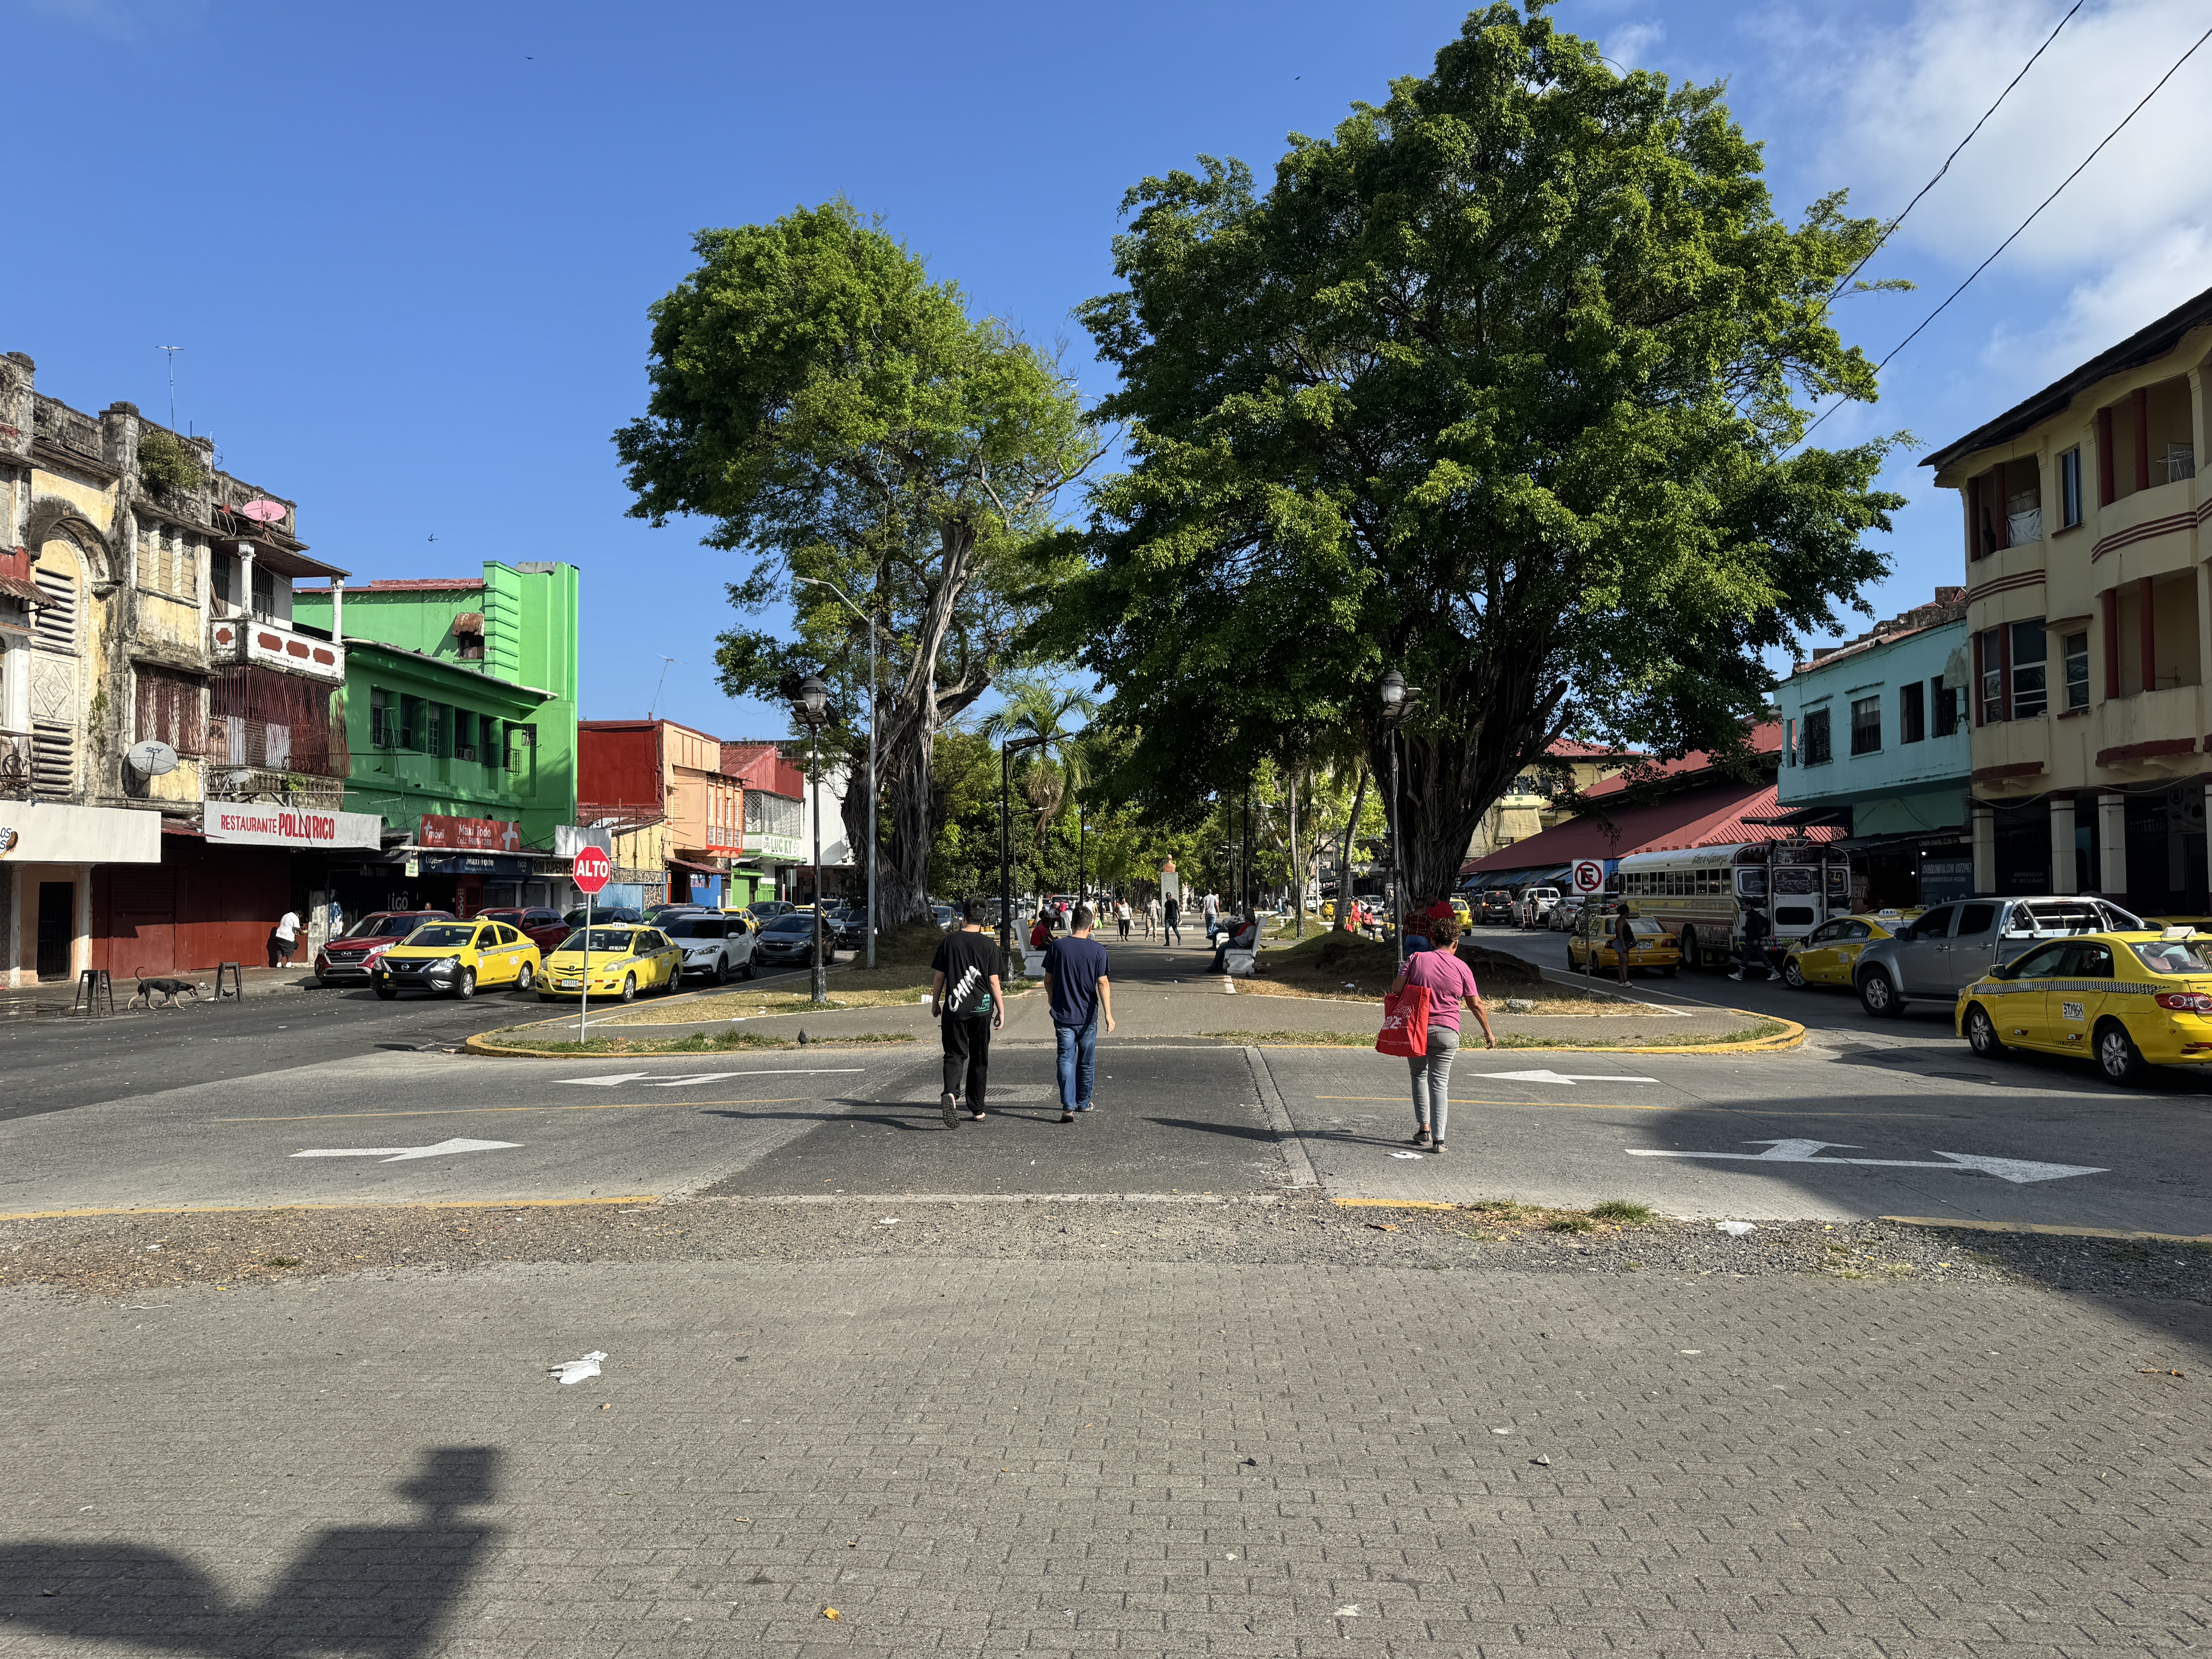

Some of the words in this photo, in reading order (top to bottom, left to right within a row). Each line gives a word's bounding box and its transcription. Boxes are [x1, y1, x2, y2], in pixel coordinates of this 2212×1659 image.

[221, 814, 277, 833] RESTAURANTE
[278, 813, 310, 838] POLLO
[312, 815, 335, 840] RICO
[459, 824, 474, 836] Maxi
[476, 825, 491, 837] Todo
[468, 837, 492, 846] 6988-1288
[771, 837, 792, 854] LUCKY
[466, 855, 479, 866] Maxi
[546, 860, 563, 873] SUPER
[576, 859, 608, 878] ALTO
[1581, 868, 1594, 885] E
